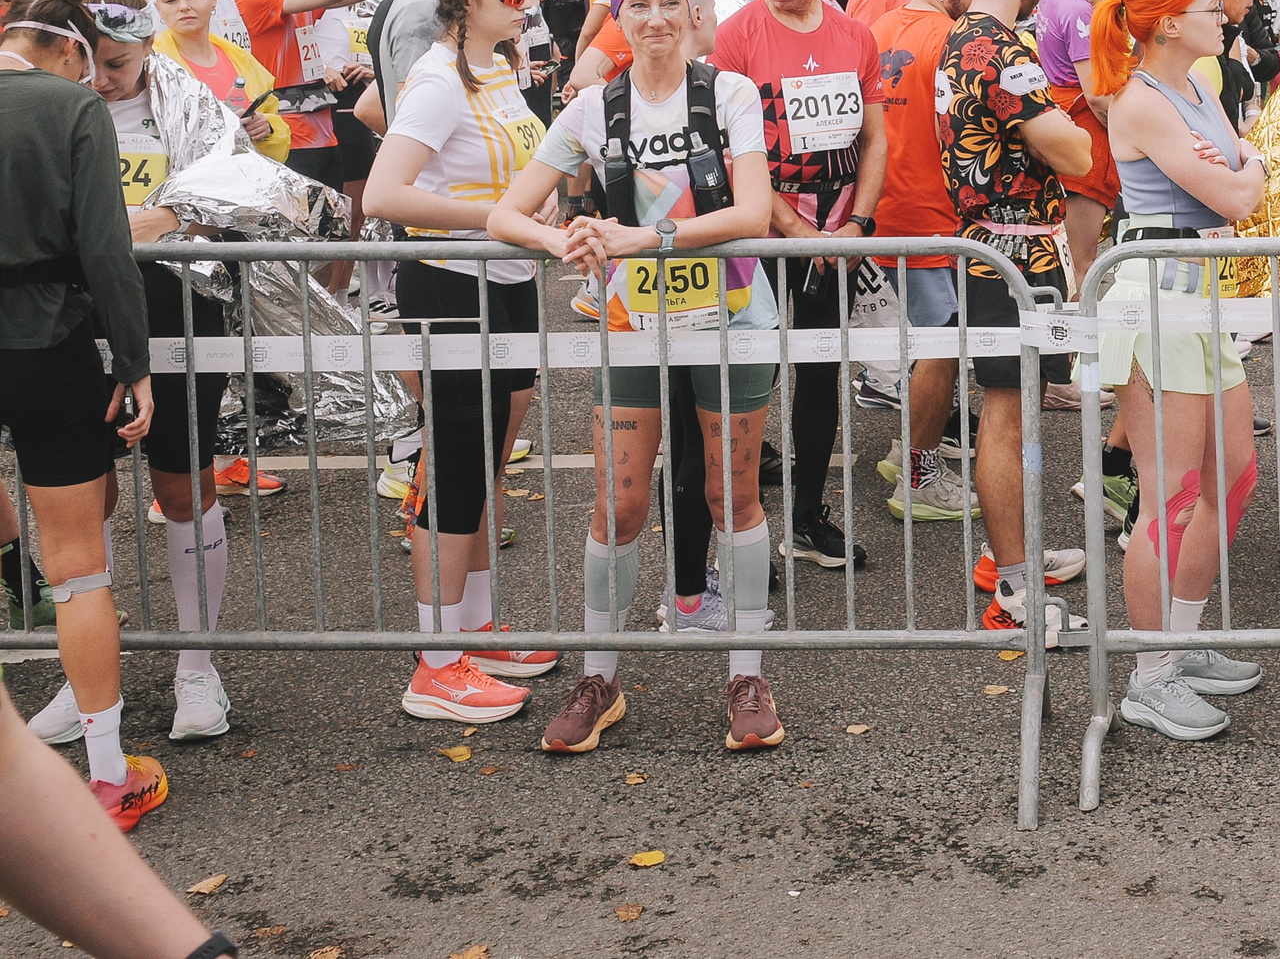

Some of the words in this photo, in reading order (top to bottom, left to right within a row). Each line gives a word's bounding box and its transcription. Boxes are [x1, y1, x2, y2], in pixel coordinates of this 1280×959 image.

[788, 91, 861, 121] 20123
[815, 118, 844, 128] АЛЕКСЕЙ
[636, 261, 710, 295] 2450
